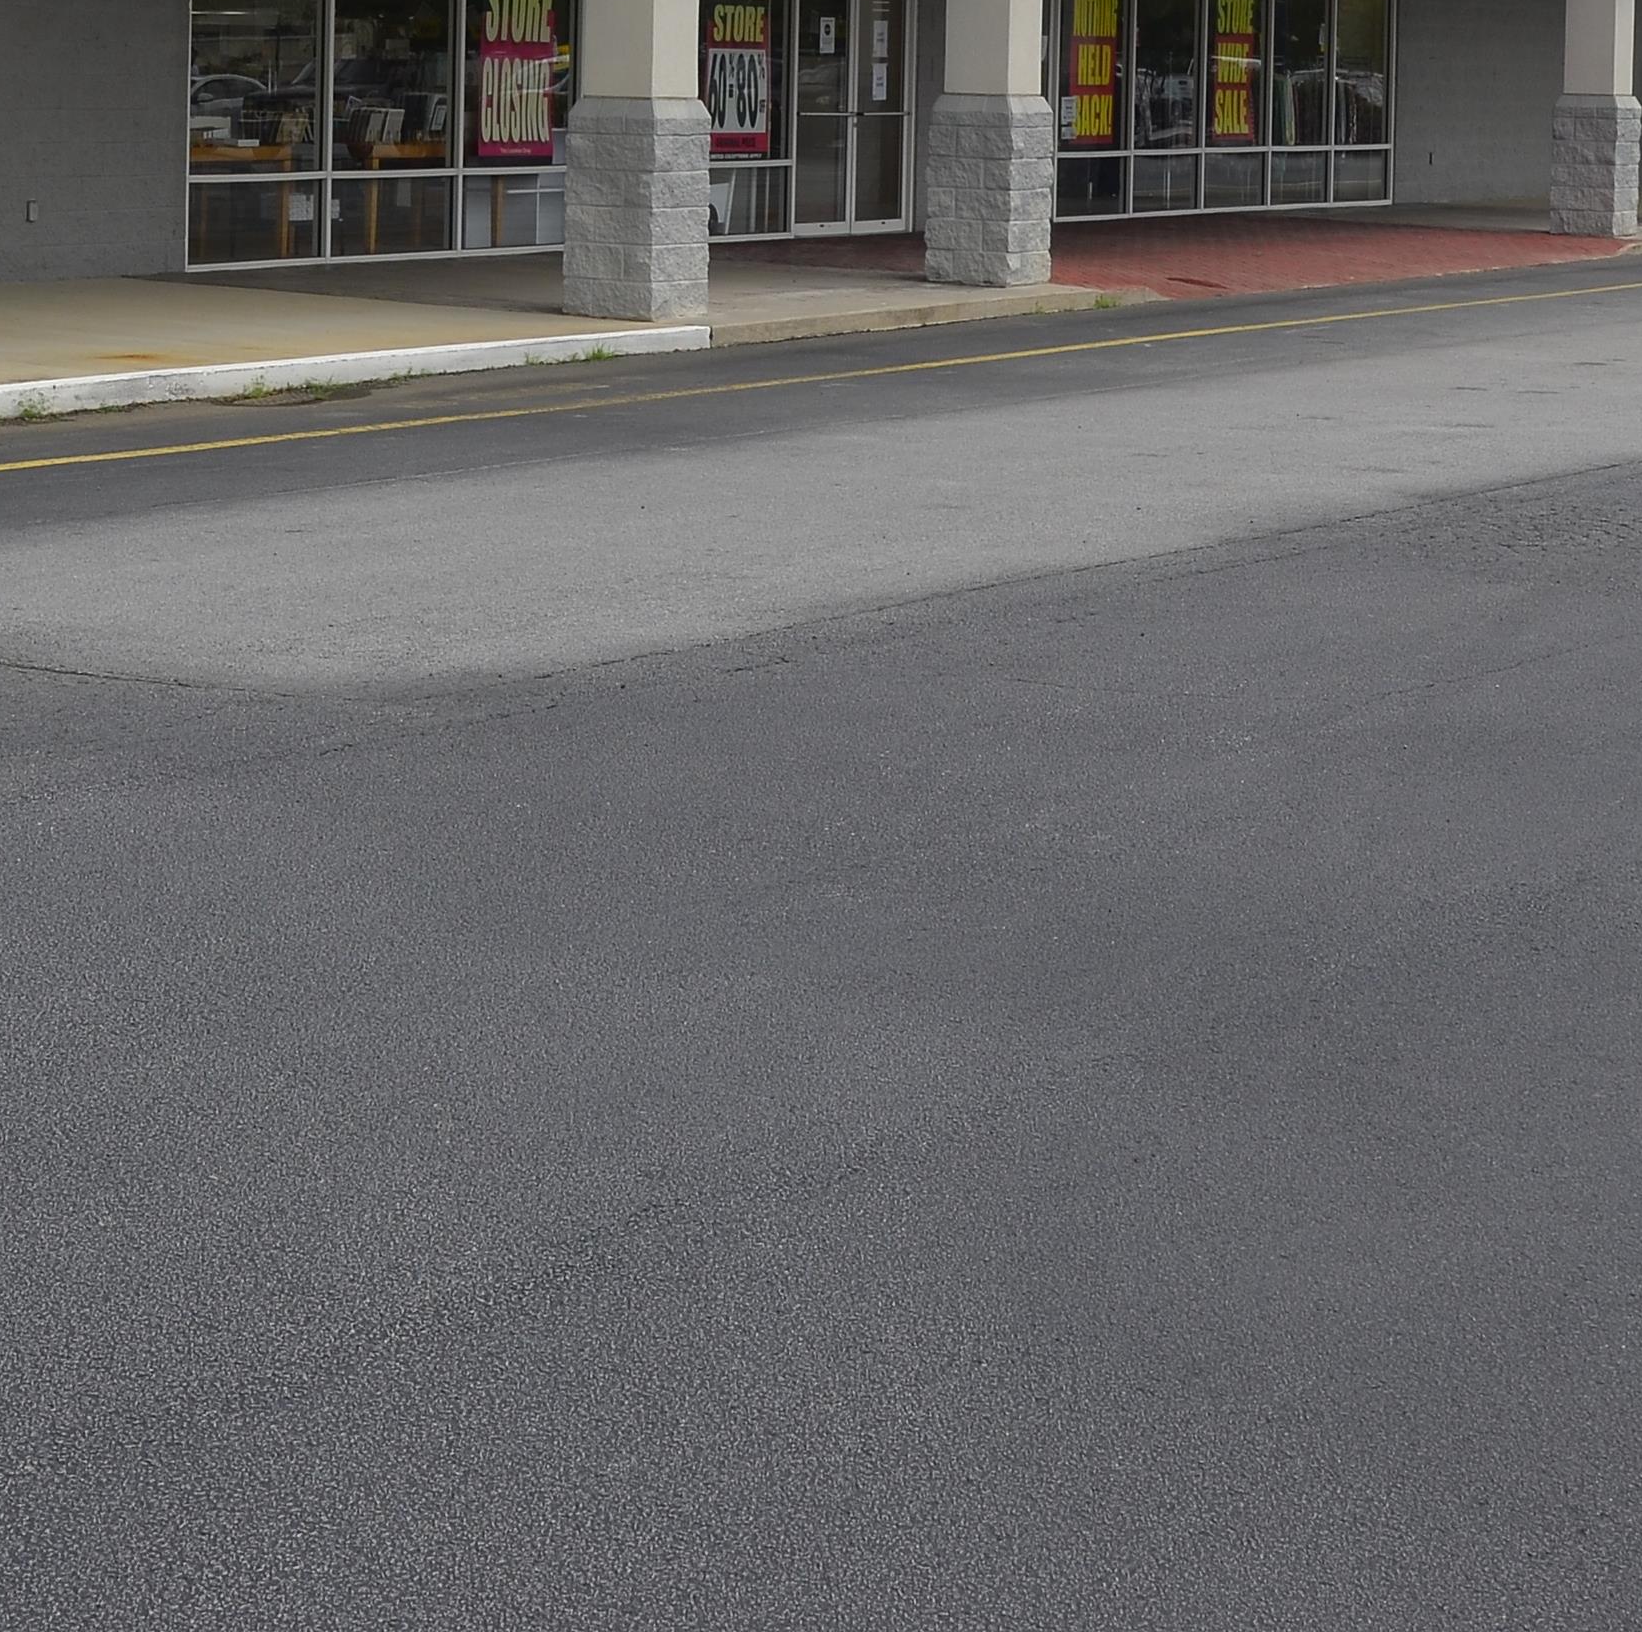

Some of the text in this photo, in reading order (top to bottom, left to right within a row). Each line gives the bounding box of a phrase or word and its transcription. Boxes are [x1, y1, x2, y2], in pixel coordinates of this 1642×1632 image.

[713, 3, 765, 43] STORE
[1077, 44, 1111, 86] HELD
[1218, 42, 1250, 83] WIDE
[481, 56, 551, 144] CLOSING
[1215, 89, 1250, 135] SALE
